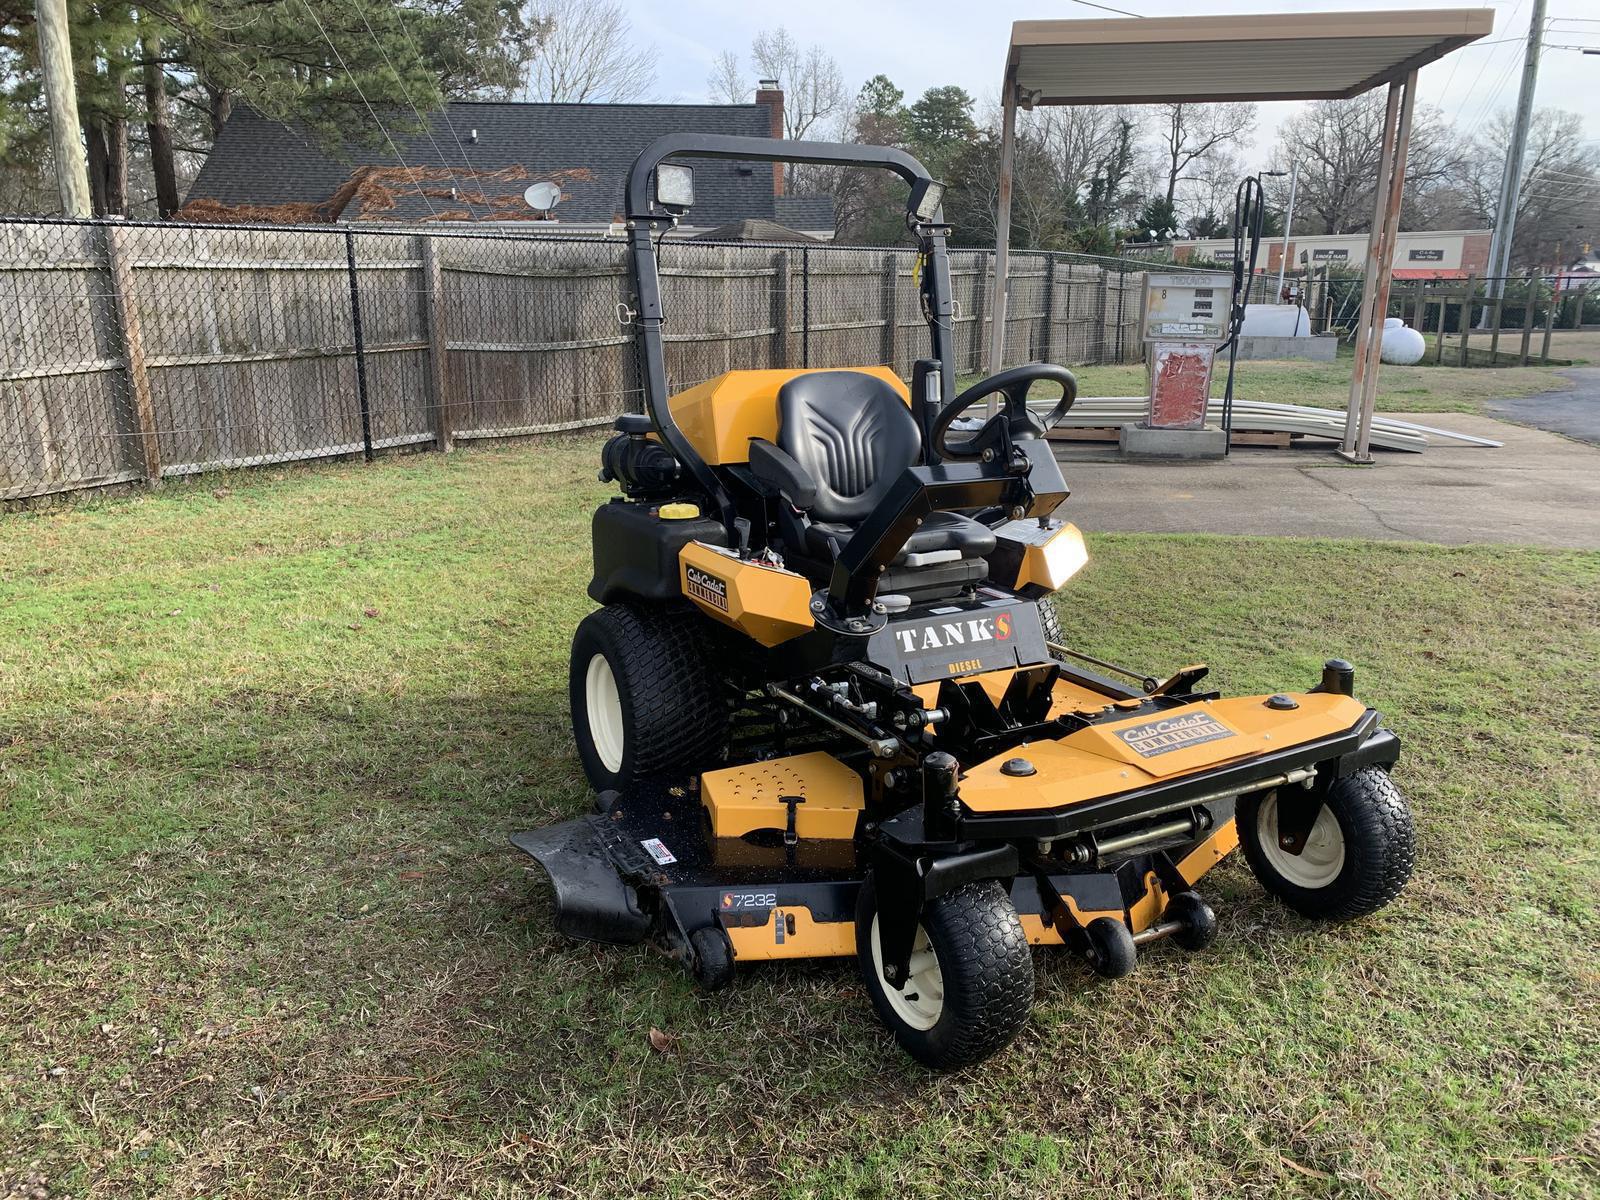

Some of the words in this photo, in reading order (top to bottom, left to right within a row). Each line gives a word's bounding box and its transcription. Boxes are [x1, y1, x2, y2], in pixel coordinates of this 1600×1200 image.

[688, 568, 701, 584] Cub
[948, 659, 982, 674] DIESEL
[1123, 726, 1157, 741] Cub
[1156, 714, 1209, 733] Cadet
[1132, 722, 1225, 752] COMMERCIAL
